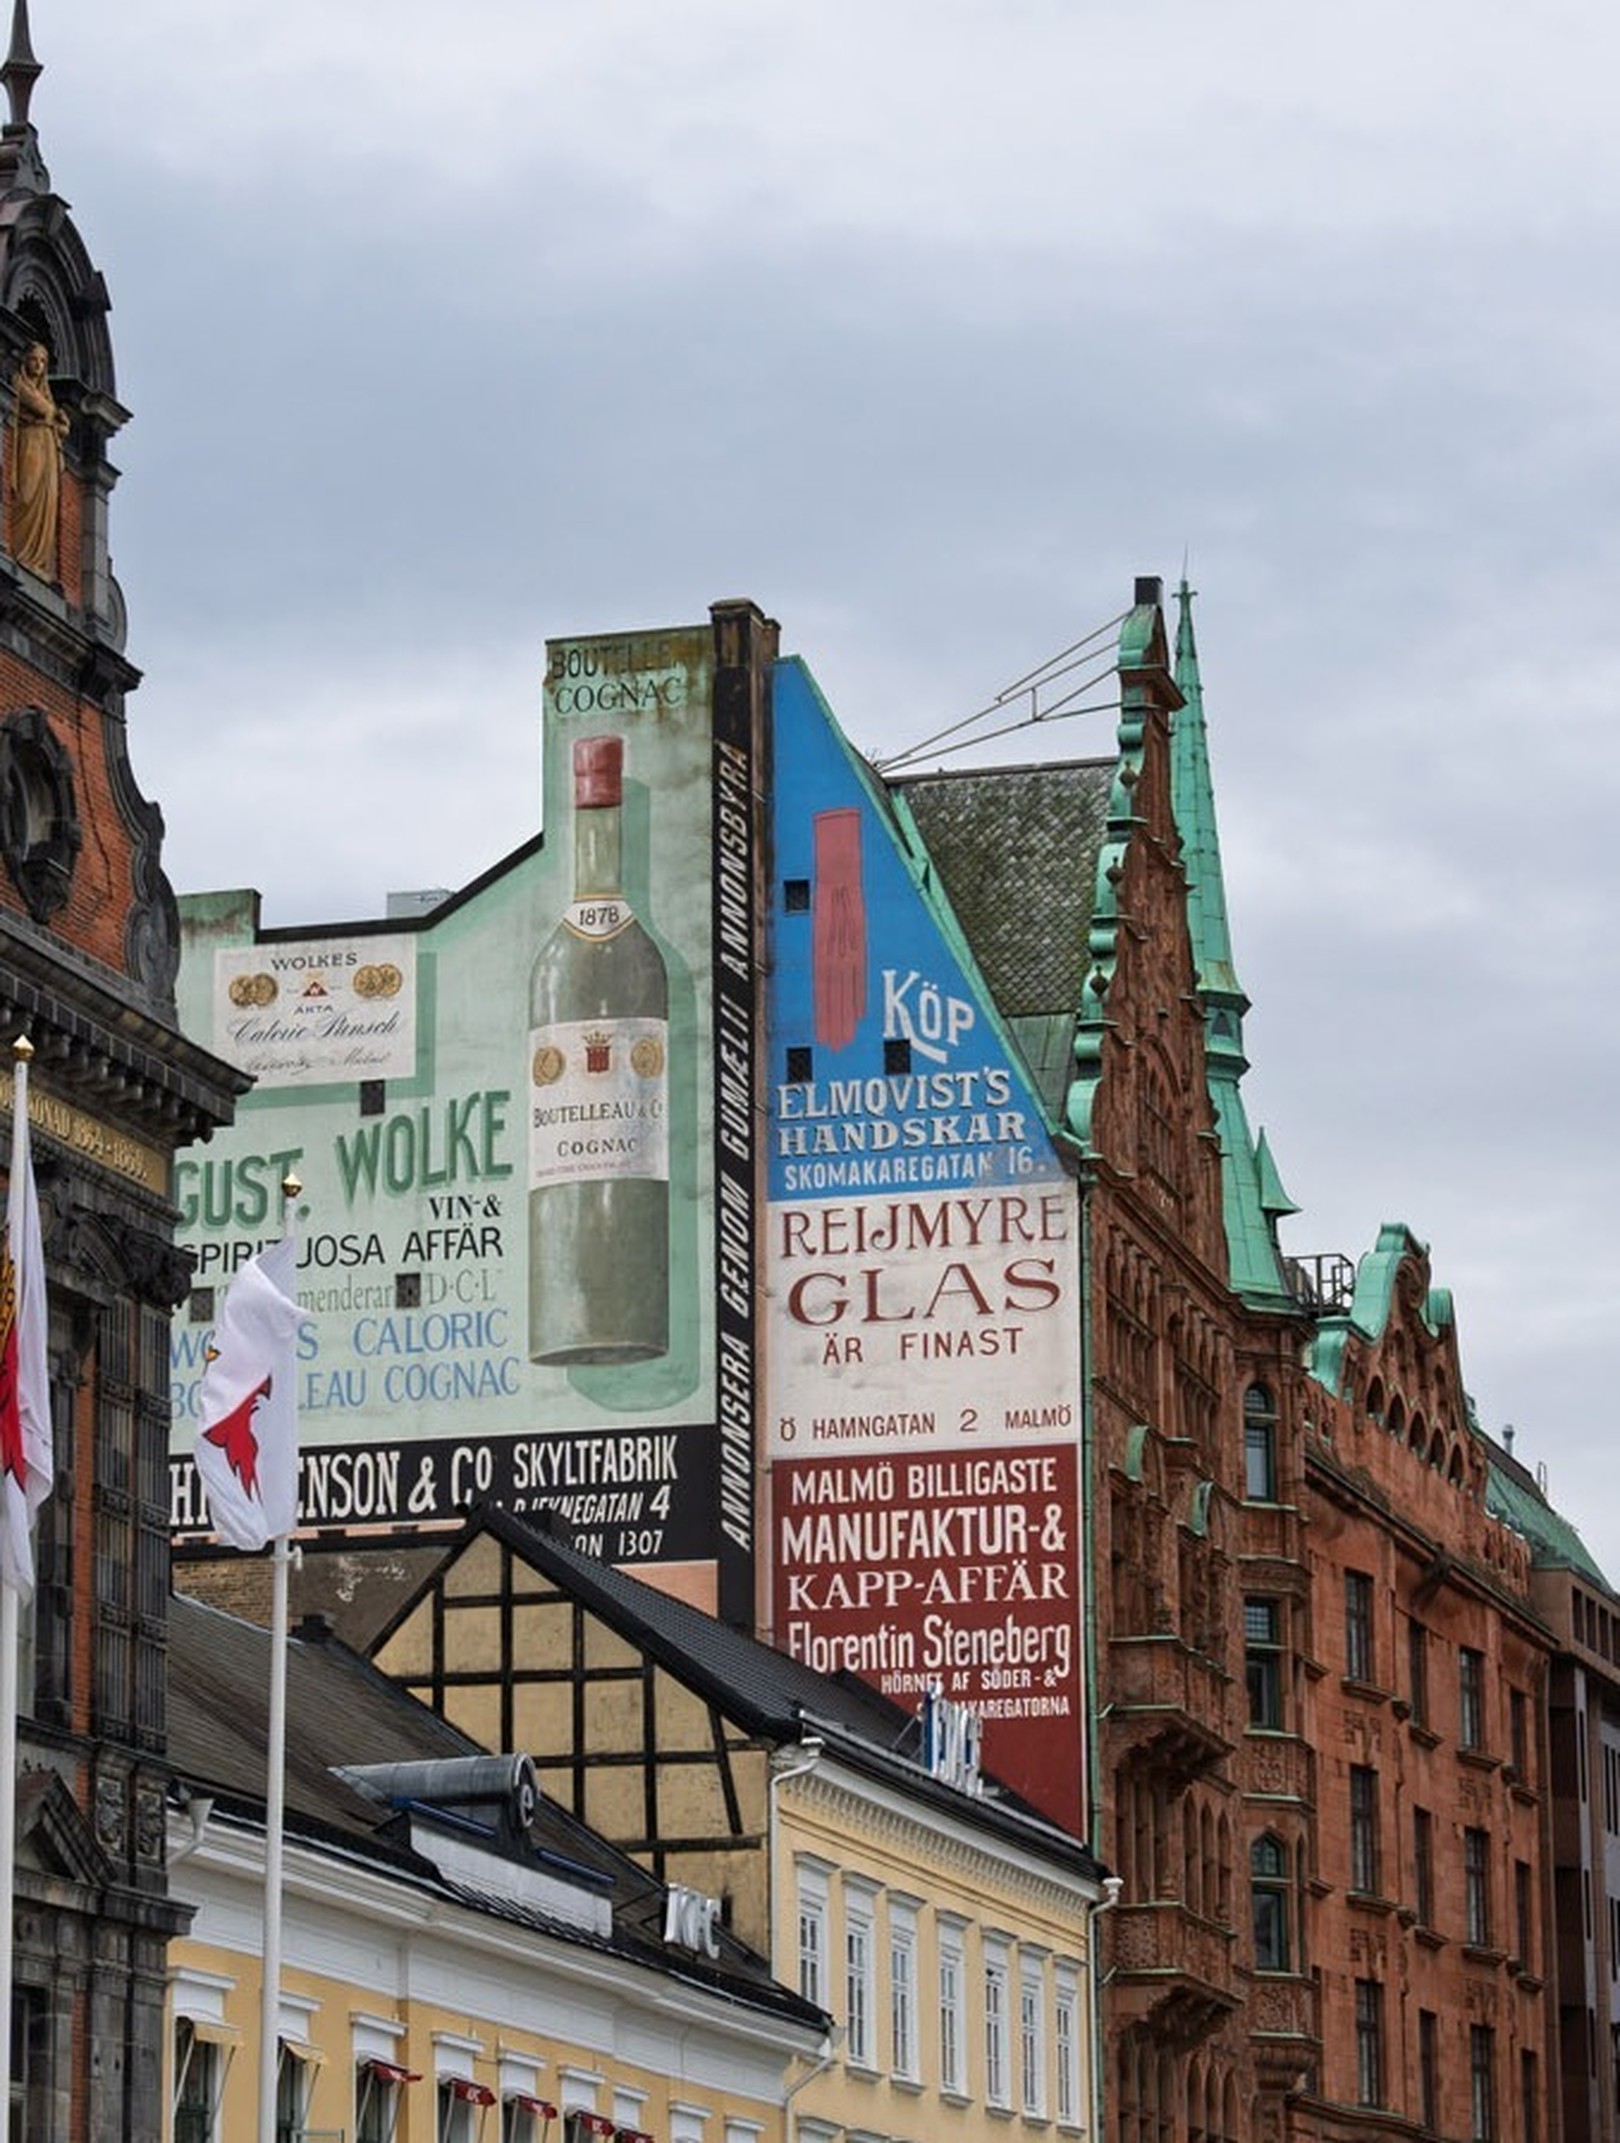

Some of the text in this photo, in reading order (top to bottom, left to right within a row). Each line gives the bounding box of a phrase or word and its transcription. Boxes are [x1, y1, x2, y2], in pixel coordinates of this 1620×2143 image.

[555, 676, 681, 714] COGNAC
[580, 905, 619, 926] 1878
[271, 953, 358, 971] WOLKES
[882, 970, 975, 1064] KÖP
[778, 1066, 1011, 1120] ELMQVIST'S
[334, 1090, 512, 1210] WOLKE
[557, 1138, 638, 1157] COGNAC
[778, 1112, 1026, 1157] HANDSKAR
[785, 1152, 993, 1191] SKOMAKAREGATAN
[402, 1222, 503, 1262] AFFÄR
[720, 1170, 749, 1319] GENOM
[780, 1194, 1068, 1258] REIJMYRE
[788, 1258, 1061, 1325] GLAS
[353, 1309, 508, 1356] CALORIC
[823, 1328, 1023, 1365] ÄR FINAST
[385, 1357, 521, 1403] COGNAC
[720, 1332, 750, 1552] ANNONSERA
[812, 1413, 935, 1439] HAMNGATAN
[960, 1409, 978, 1432] 2
[1005, 1405, 1072, 1430] MALMÖ
[408, 1456, 438, 1513] &
[514, 1435, 678, 1489] SKYLTFABRIK
[792, 1457, 1057, 1506] MALMÖ BILLIGASTE
[650, 1485, 671, 1520] 4
[618, 1530, 663, 1557] 1307
[788, 1559, 1070, 1611] KAPP-AFFÄR
[788, 1614, 1071, 1678] Florentin Steneberg
[952, 1671, 971, 1691] AF
